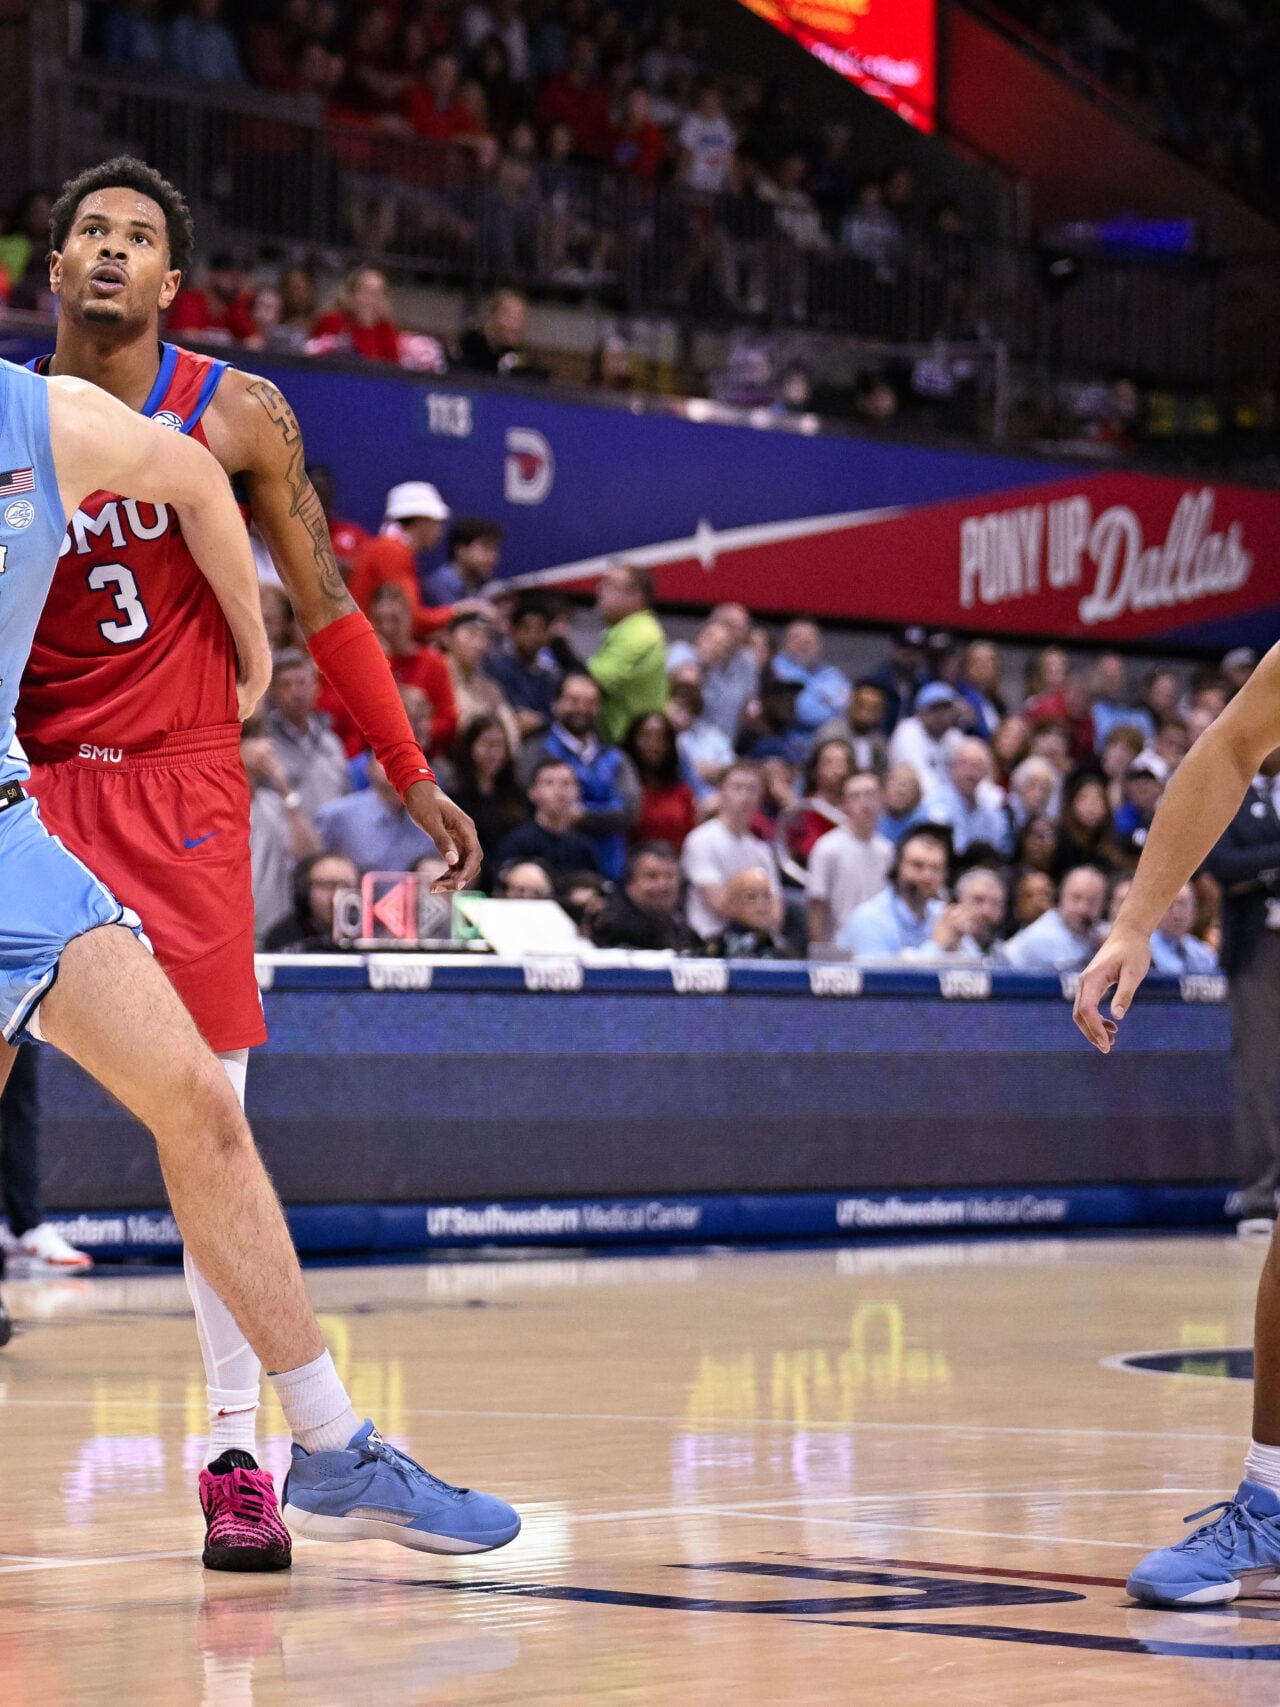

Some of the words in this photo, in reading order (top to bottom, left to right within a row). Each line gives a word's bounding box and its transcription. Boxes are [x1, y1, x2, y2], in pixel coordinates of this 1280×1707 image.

[426, 392, 472, 438] 113
[58, 497, 169, 557] MU
[960, 504, 1044, 610] PONY
[1046, 494, 1091, 590] UP
[1077, 486, 1254, 626] Dallas
[87, 562, 151, 644] 3
[78, 743, 123, 763] SMU
